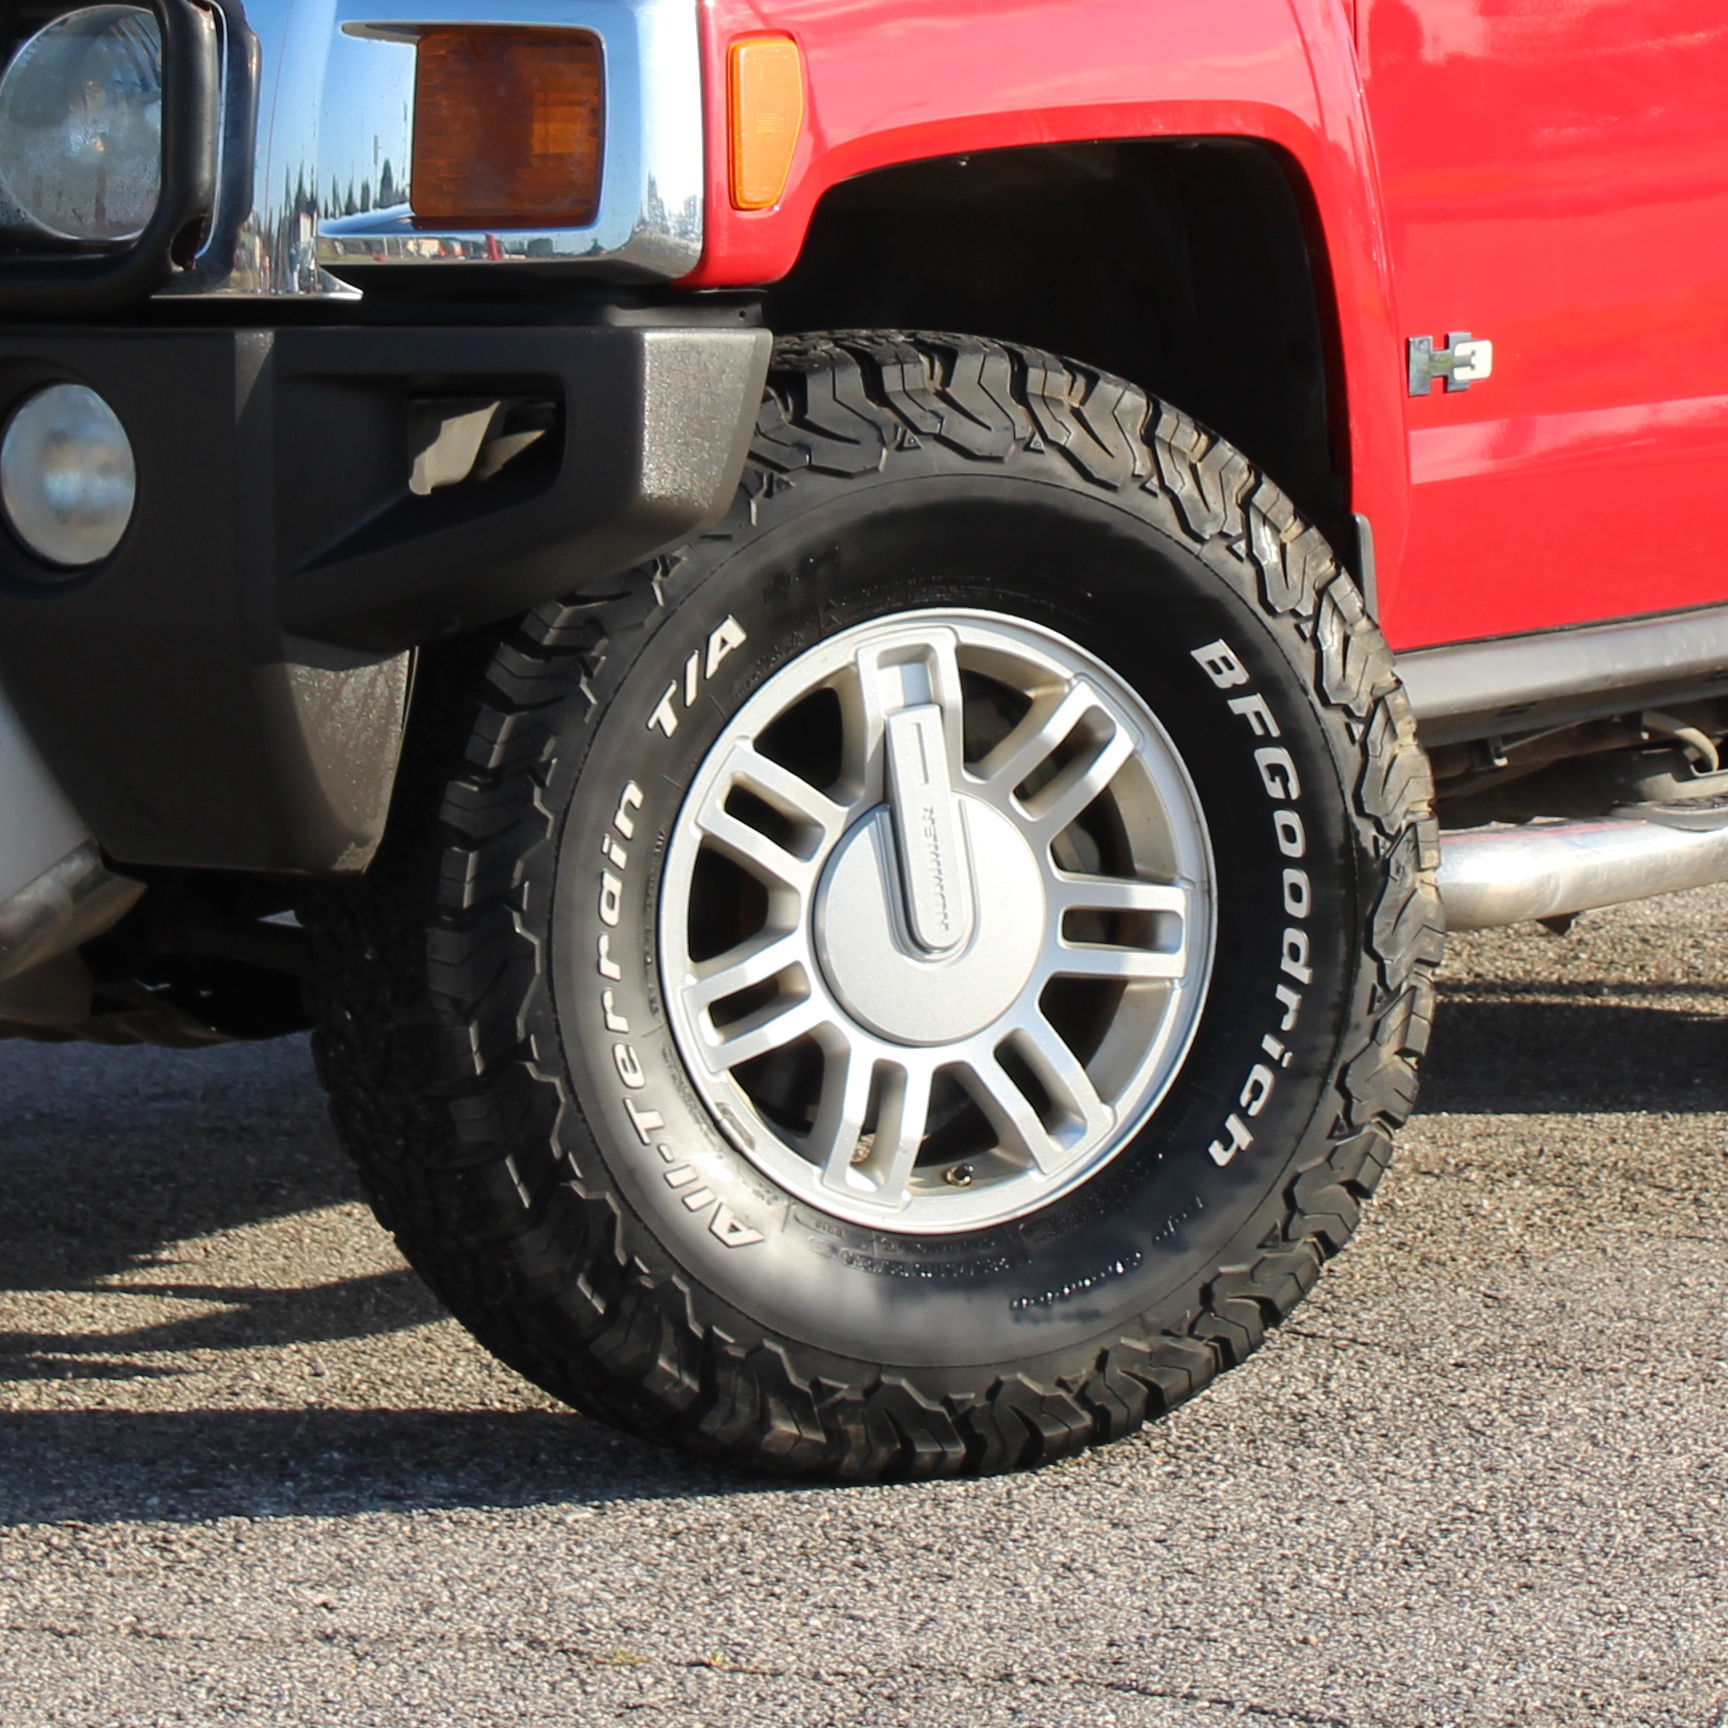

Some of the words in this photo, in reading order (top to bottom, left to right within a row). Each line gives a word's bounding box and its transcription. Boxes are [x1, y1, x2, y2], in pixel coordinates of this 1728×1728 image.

[1408, 331, 1494, 397] H3
[645, 614, 750, 741] T/A
[922, 806, 950, 932] HUMMER
[1190, 637, 1312, 1169] BFGoodrich
[593, 780, 769, 1249] All-Terrain
